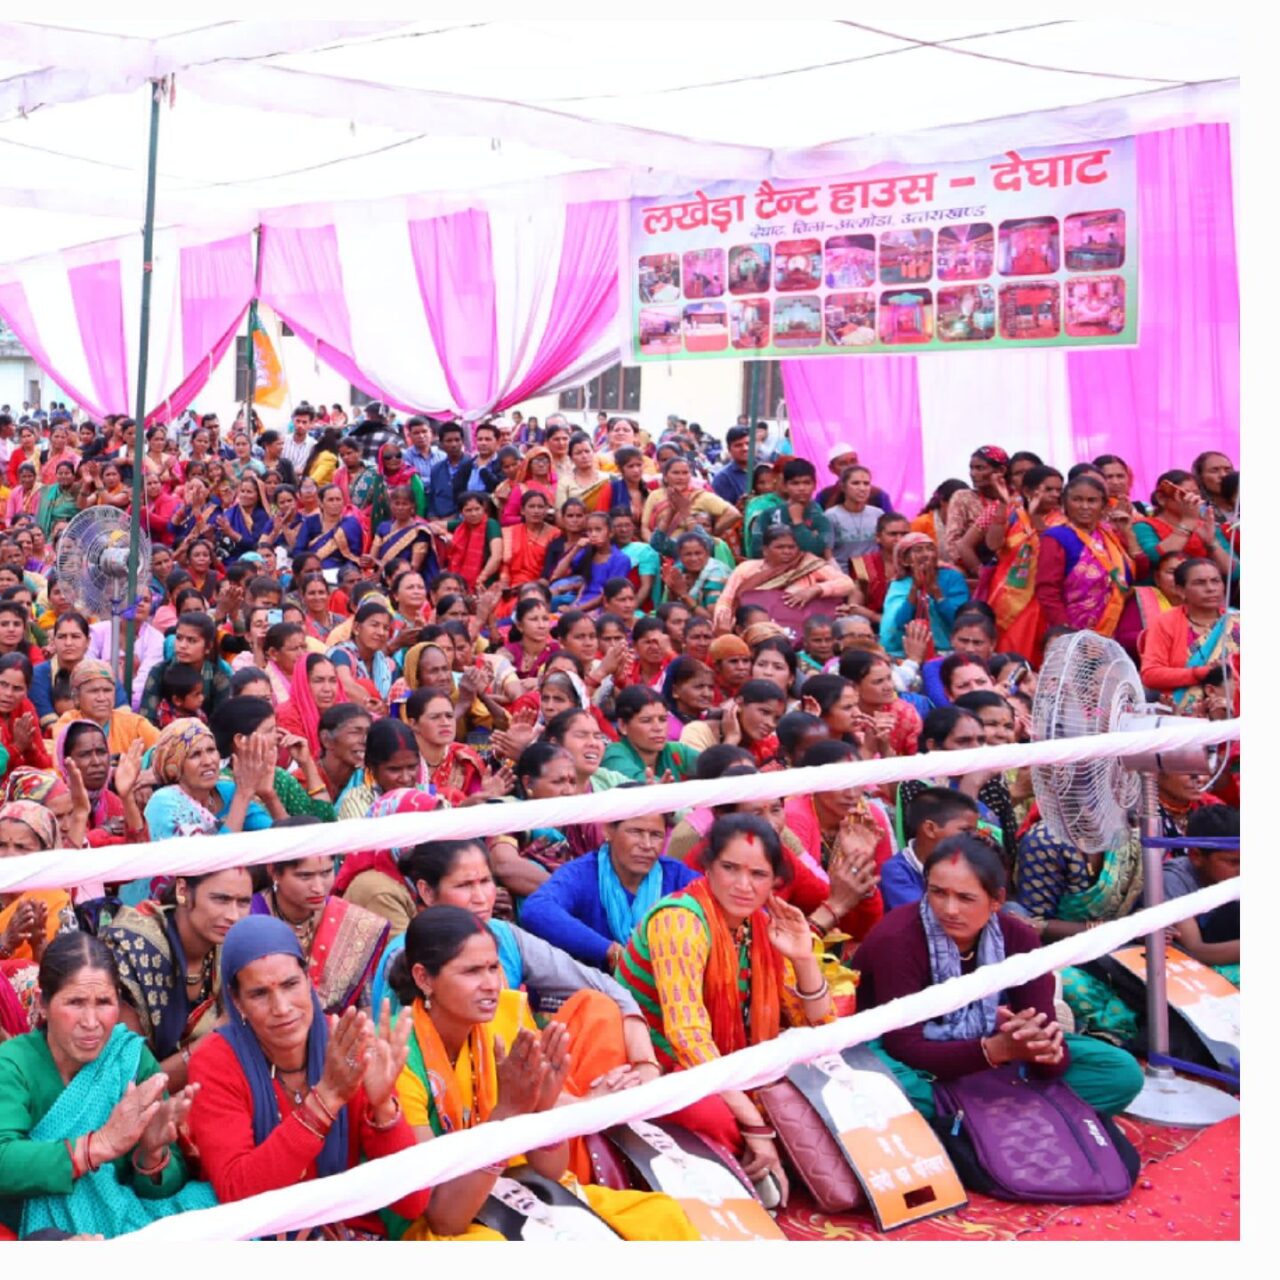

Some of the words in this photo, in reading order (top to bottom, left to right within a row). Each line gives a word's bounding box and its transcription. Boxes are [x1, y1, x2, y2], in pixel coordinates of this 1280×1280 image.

[641, 189, 746, 235] लखेड़ा
[753, 179, 822, 220] टैन्ट
[828, 172, 938, 214] हाउस
[990, 150, 1111, 192] देघाट
